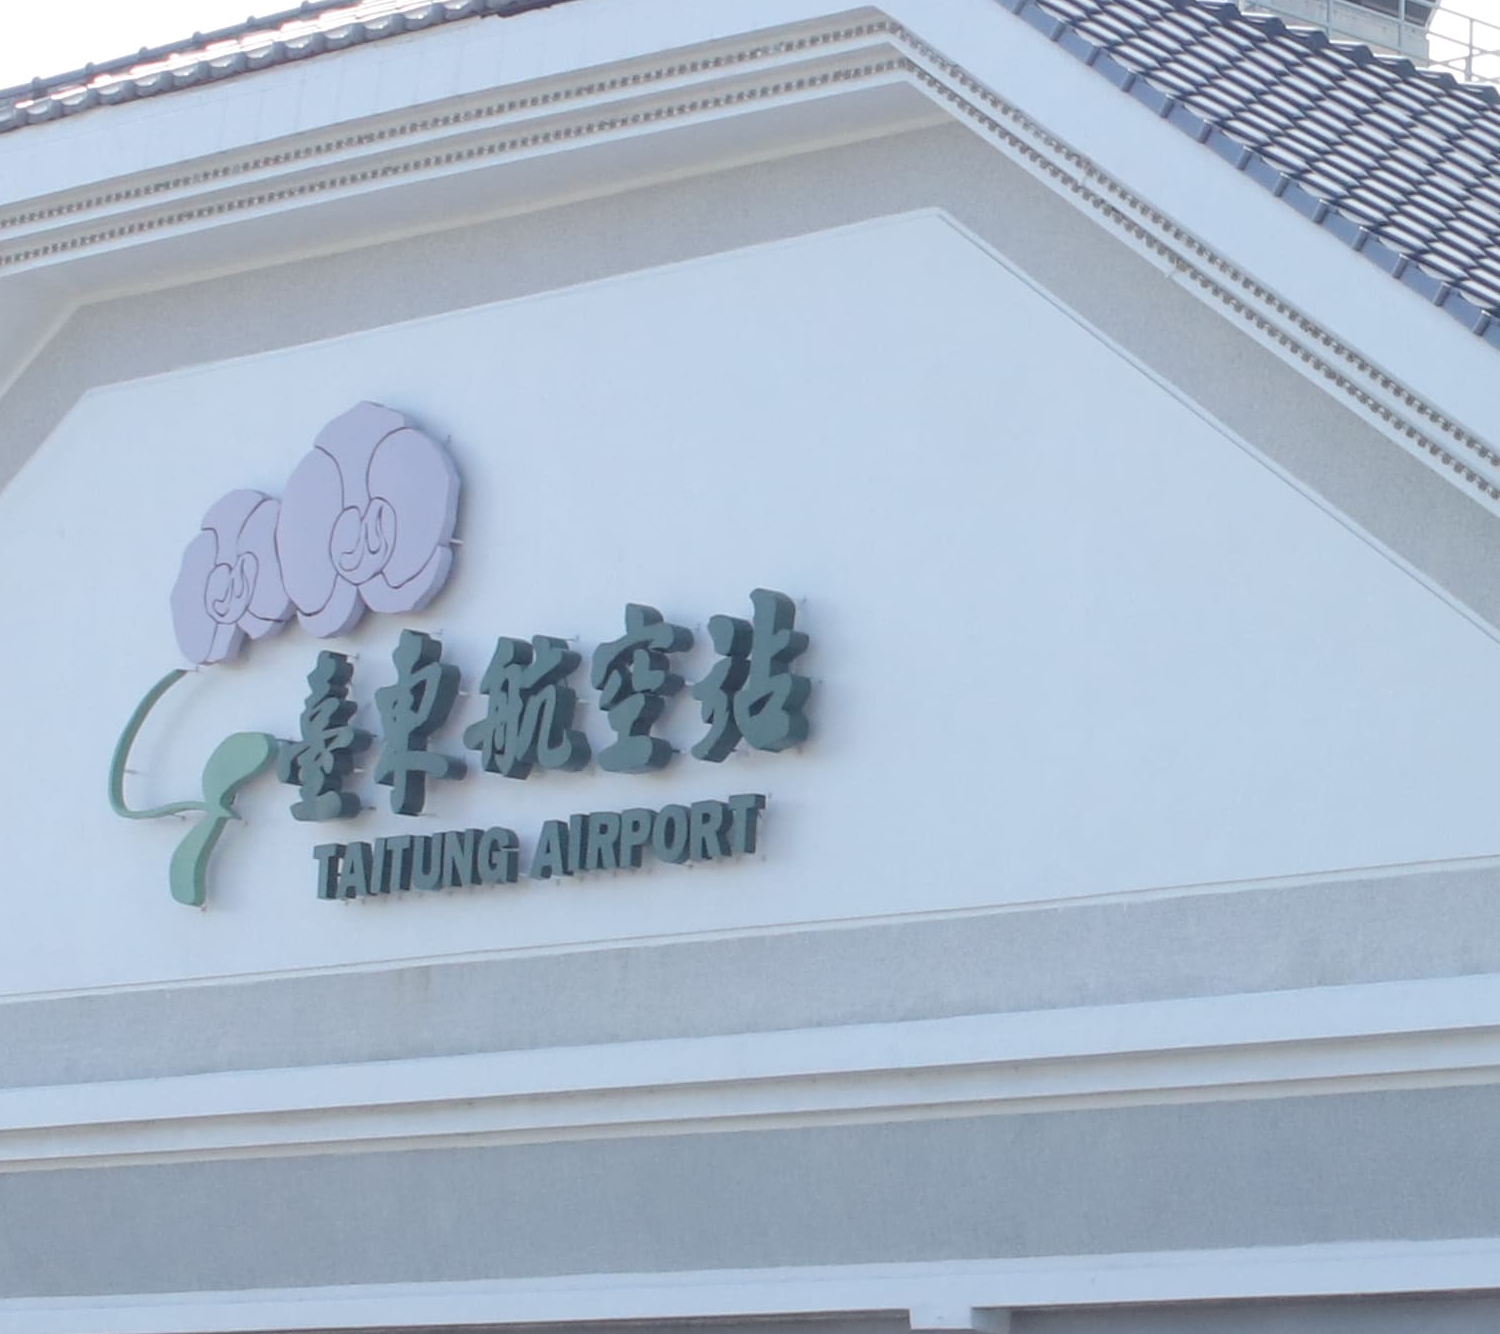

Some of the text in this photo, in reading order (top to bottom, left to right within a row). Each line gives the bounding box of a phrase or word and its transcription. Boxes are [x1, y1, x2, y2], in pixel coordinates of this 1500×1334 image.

[279, 587, 813, 824] 臺東航空站
[313, 793, 767, 901] TAITUNG AIRPORT
